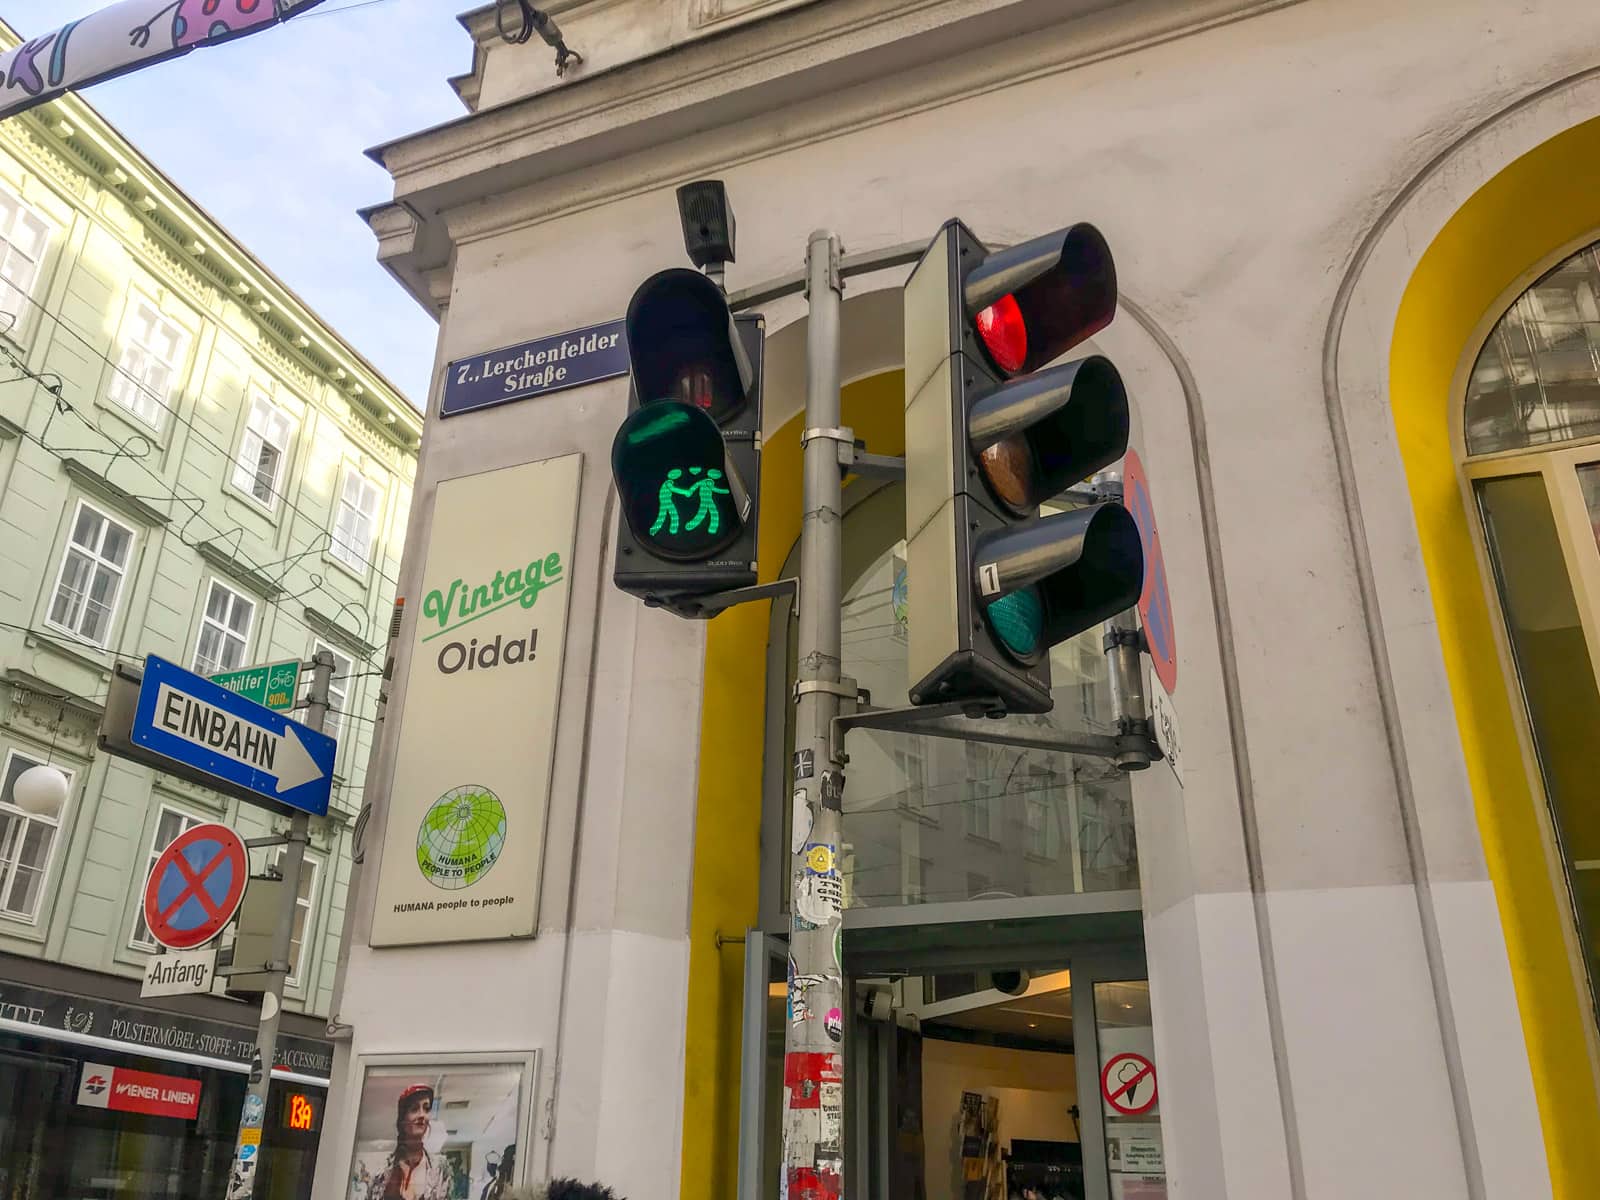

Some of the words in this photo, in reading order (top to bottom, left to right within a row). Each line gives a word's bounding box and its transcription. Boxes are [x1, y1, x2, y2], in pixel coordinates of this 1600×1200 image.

[482, 332, 620, 379] Lerchenfelder
[503, 364, 568, 393] Straße
[422, 552, 563, 628] Vintage
[984, 565, 996, 591] 1
[437, 628, 538, 674] Oida!
[162, 691, 278, 771] EINBAHN
[421, 860, 450, 877] PEOPLE
[452, 867, 463, 877] TO
[464, 852, 497, 875] PEOPLE
[438, 853, 478, 866] HUMANA
[393, 901, 434, 913] HUMANA
[436, 898, 468, 911] people
[470, 899, 480, 907] to
[482, 895, 515, 908] people
[150, 961, 206, 985] Anfang
[115, 1082, 159, 1101] WIENER
[161, 1088, 195, 1105] LINIEN
[290, 1095, 312, 1129] 13A
